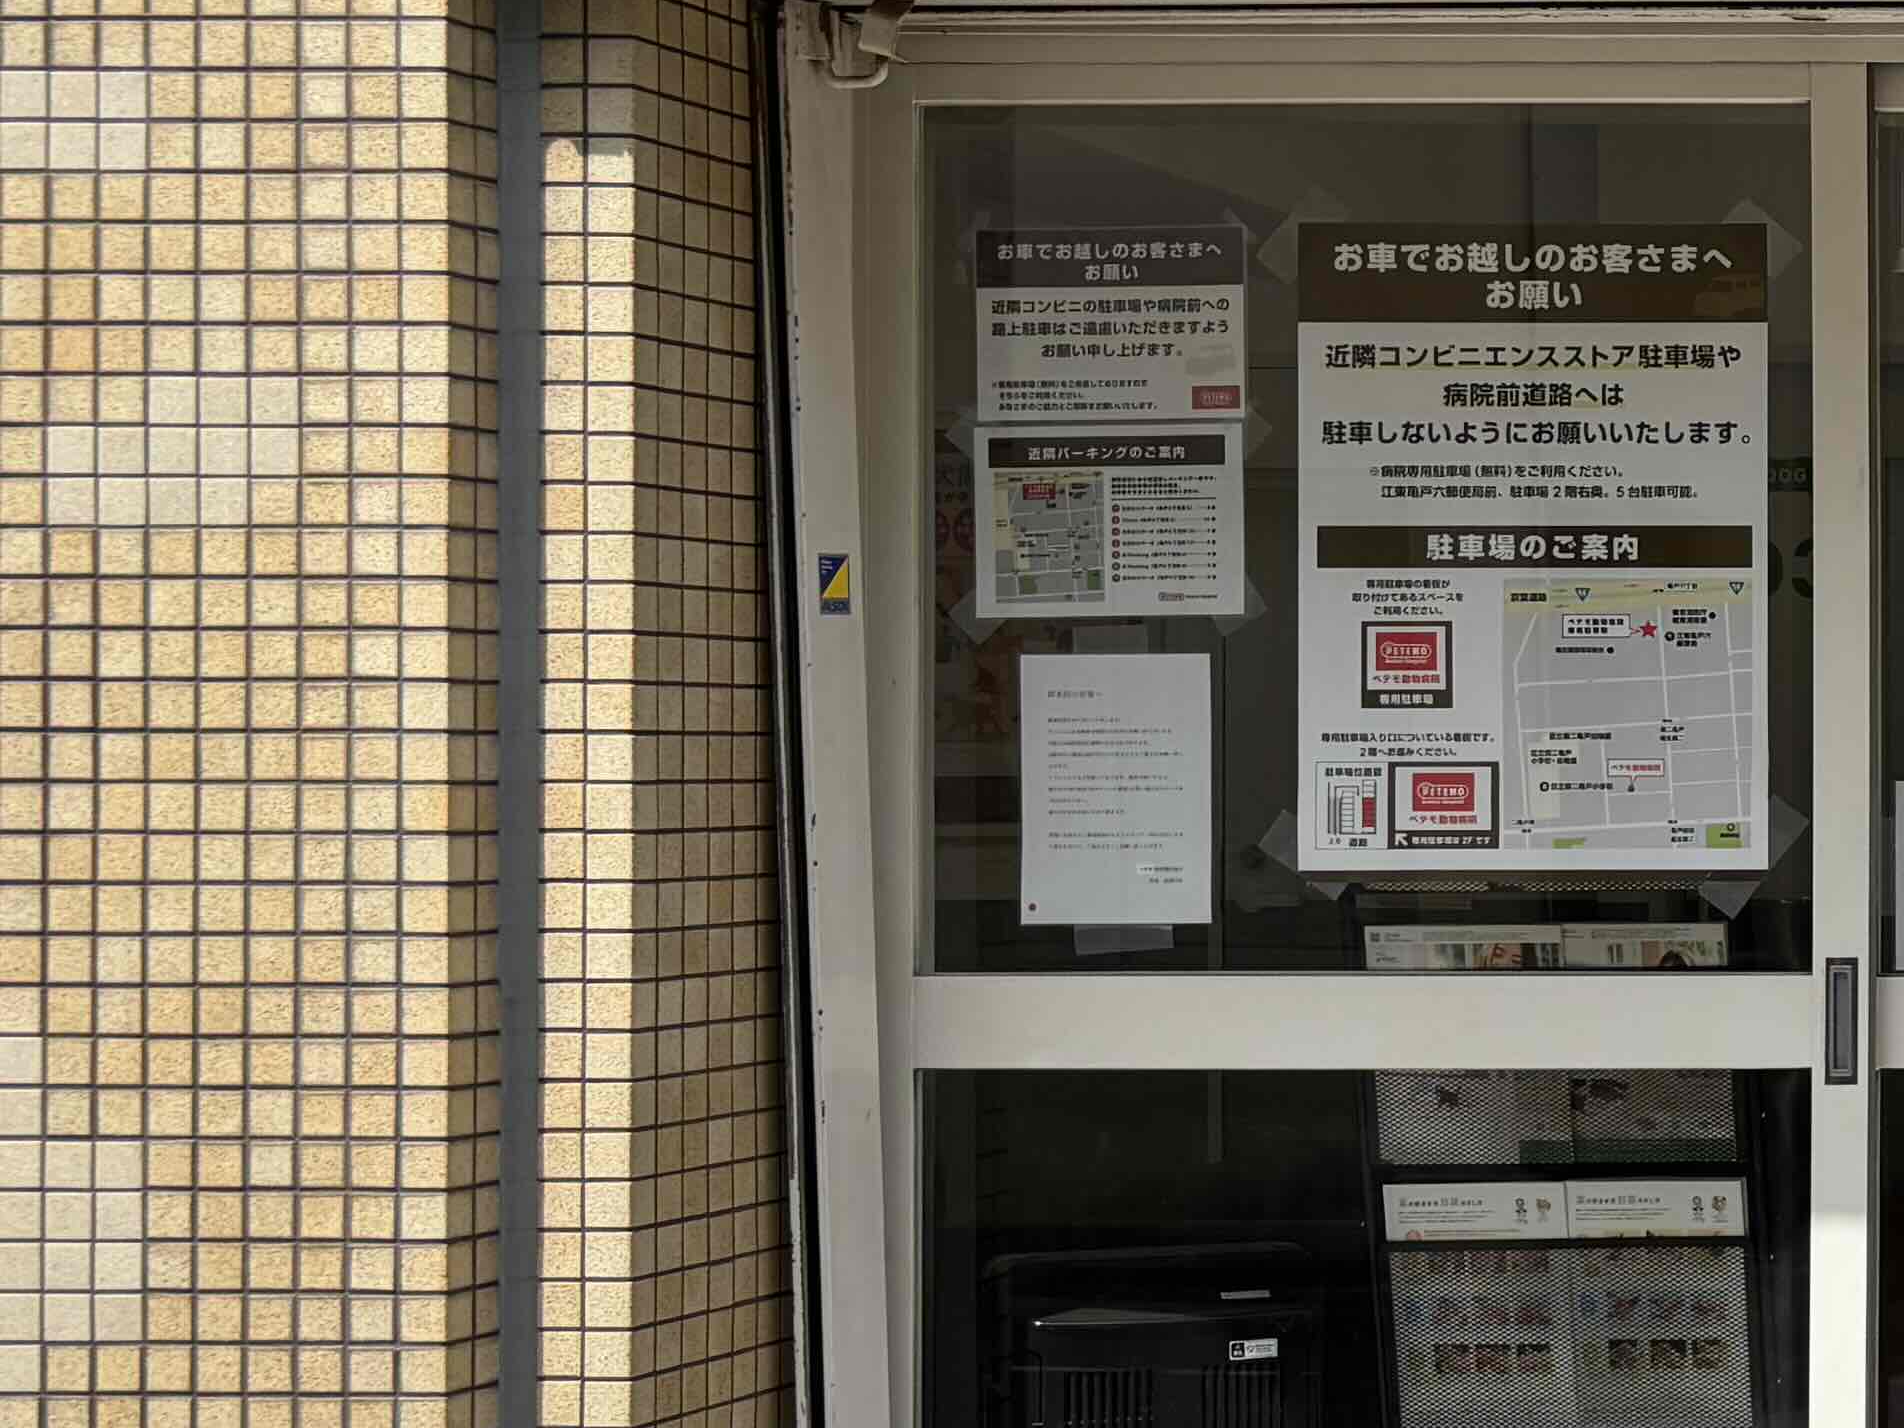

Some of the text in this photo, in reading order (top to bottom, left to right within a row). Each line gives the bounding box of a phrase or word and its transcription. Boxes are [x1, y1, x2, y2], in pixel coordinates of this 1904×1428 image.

[997, 242, 1223, 262] お車でお越しのお客さまへ
[1332, 242, 1734, 275] お車でお越しのお客さまへ
[1084, 262, 1140, 282] お願い
[1485, 279, 1584, 311] お願い
[1041, 341, 1184, 359] お願い申し上げます。
[1324, 343, 1742, 370] 近隣コンビニエンスストア駐車場や
[1442, 382, 1625, 408] 病院前道路へは
[1321, 420, 1753, 447] 駐車しないようにお願いいたします。
[1027, 445, 1187, 462] 近隣パーキングのご案内
[1425, 533, 1640, 561] 駐車場のご案内
